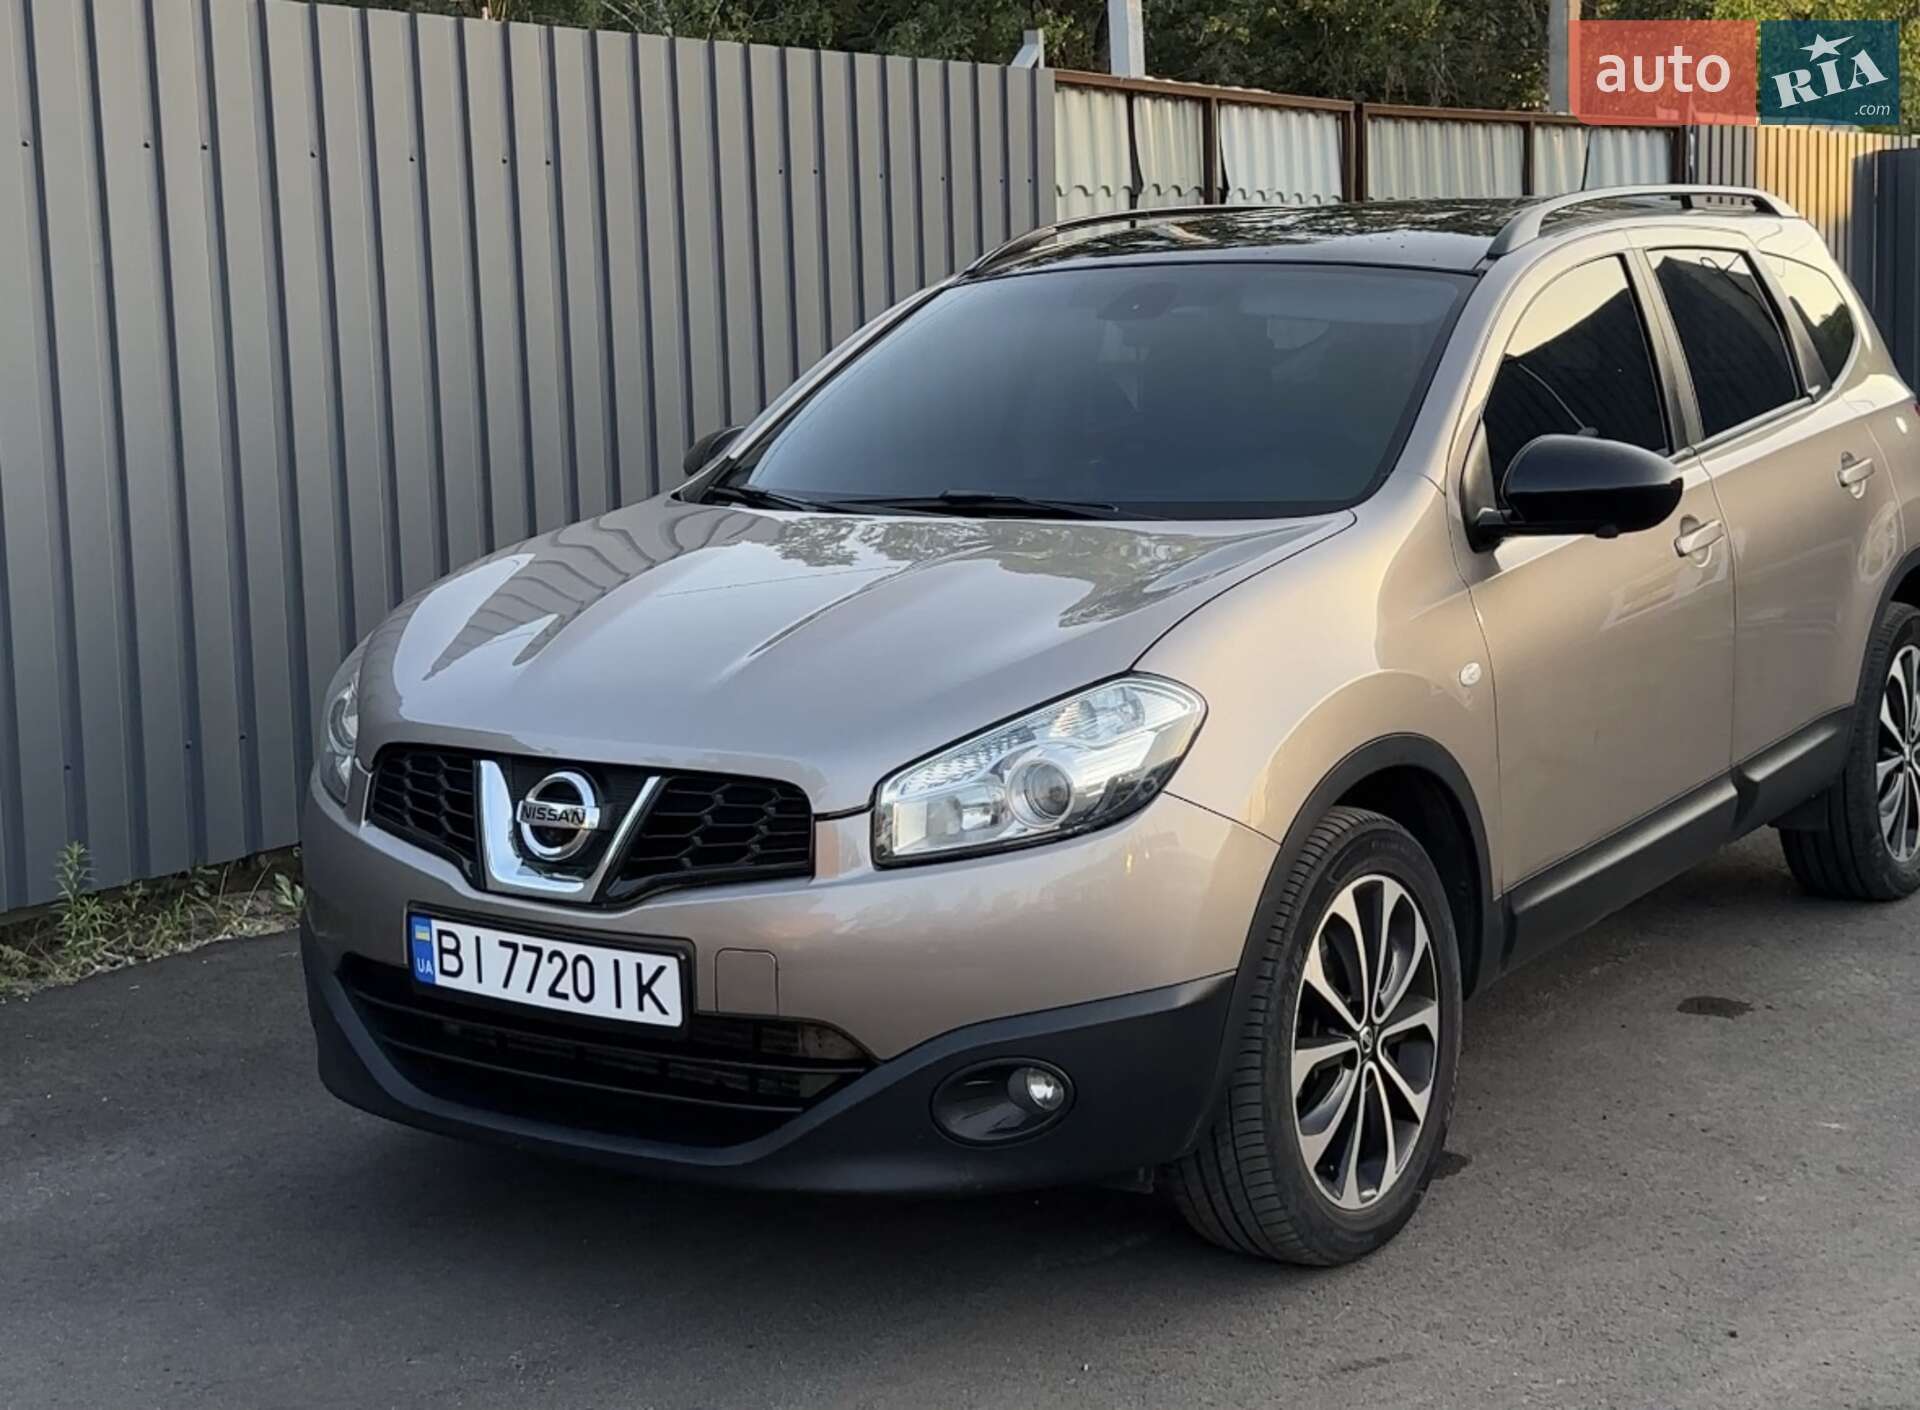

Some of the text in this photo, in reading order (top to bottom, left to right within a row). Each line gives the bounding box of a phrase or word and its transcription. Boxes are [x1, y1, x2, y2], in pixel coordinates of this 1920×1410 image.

[521, 804, 585, 826] NISSAN
[416, 959, 434, 974] UA
[437, 929, 669, 1015] BI 7720 IK
